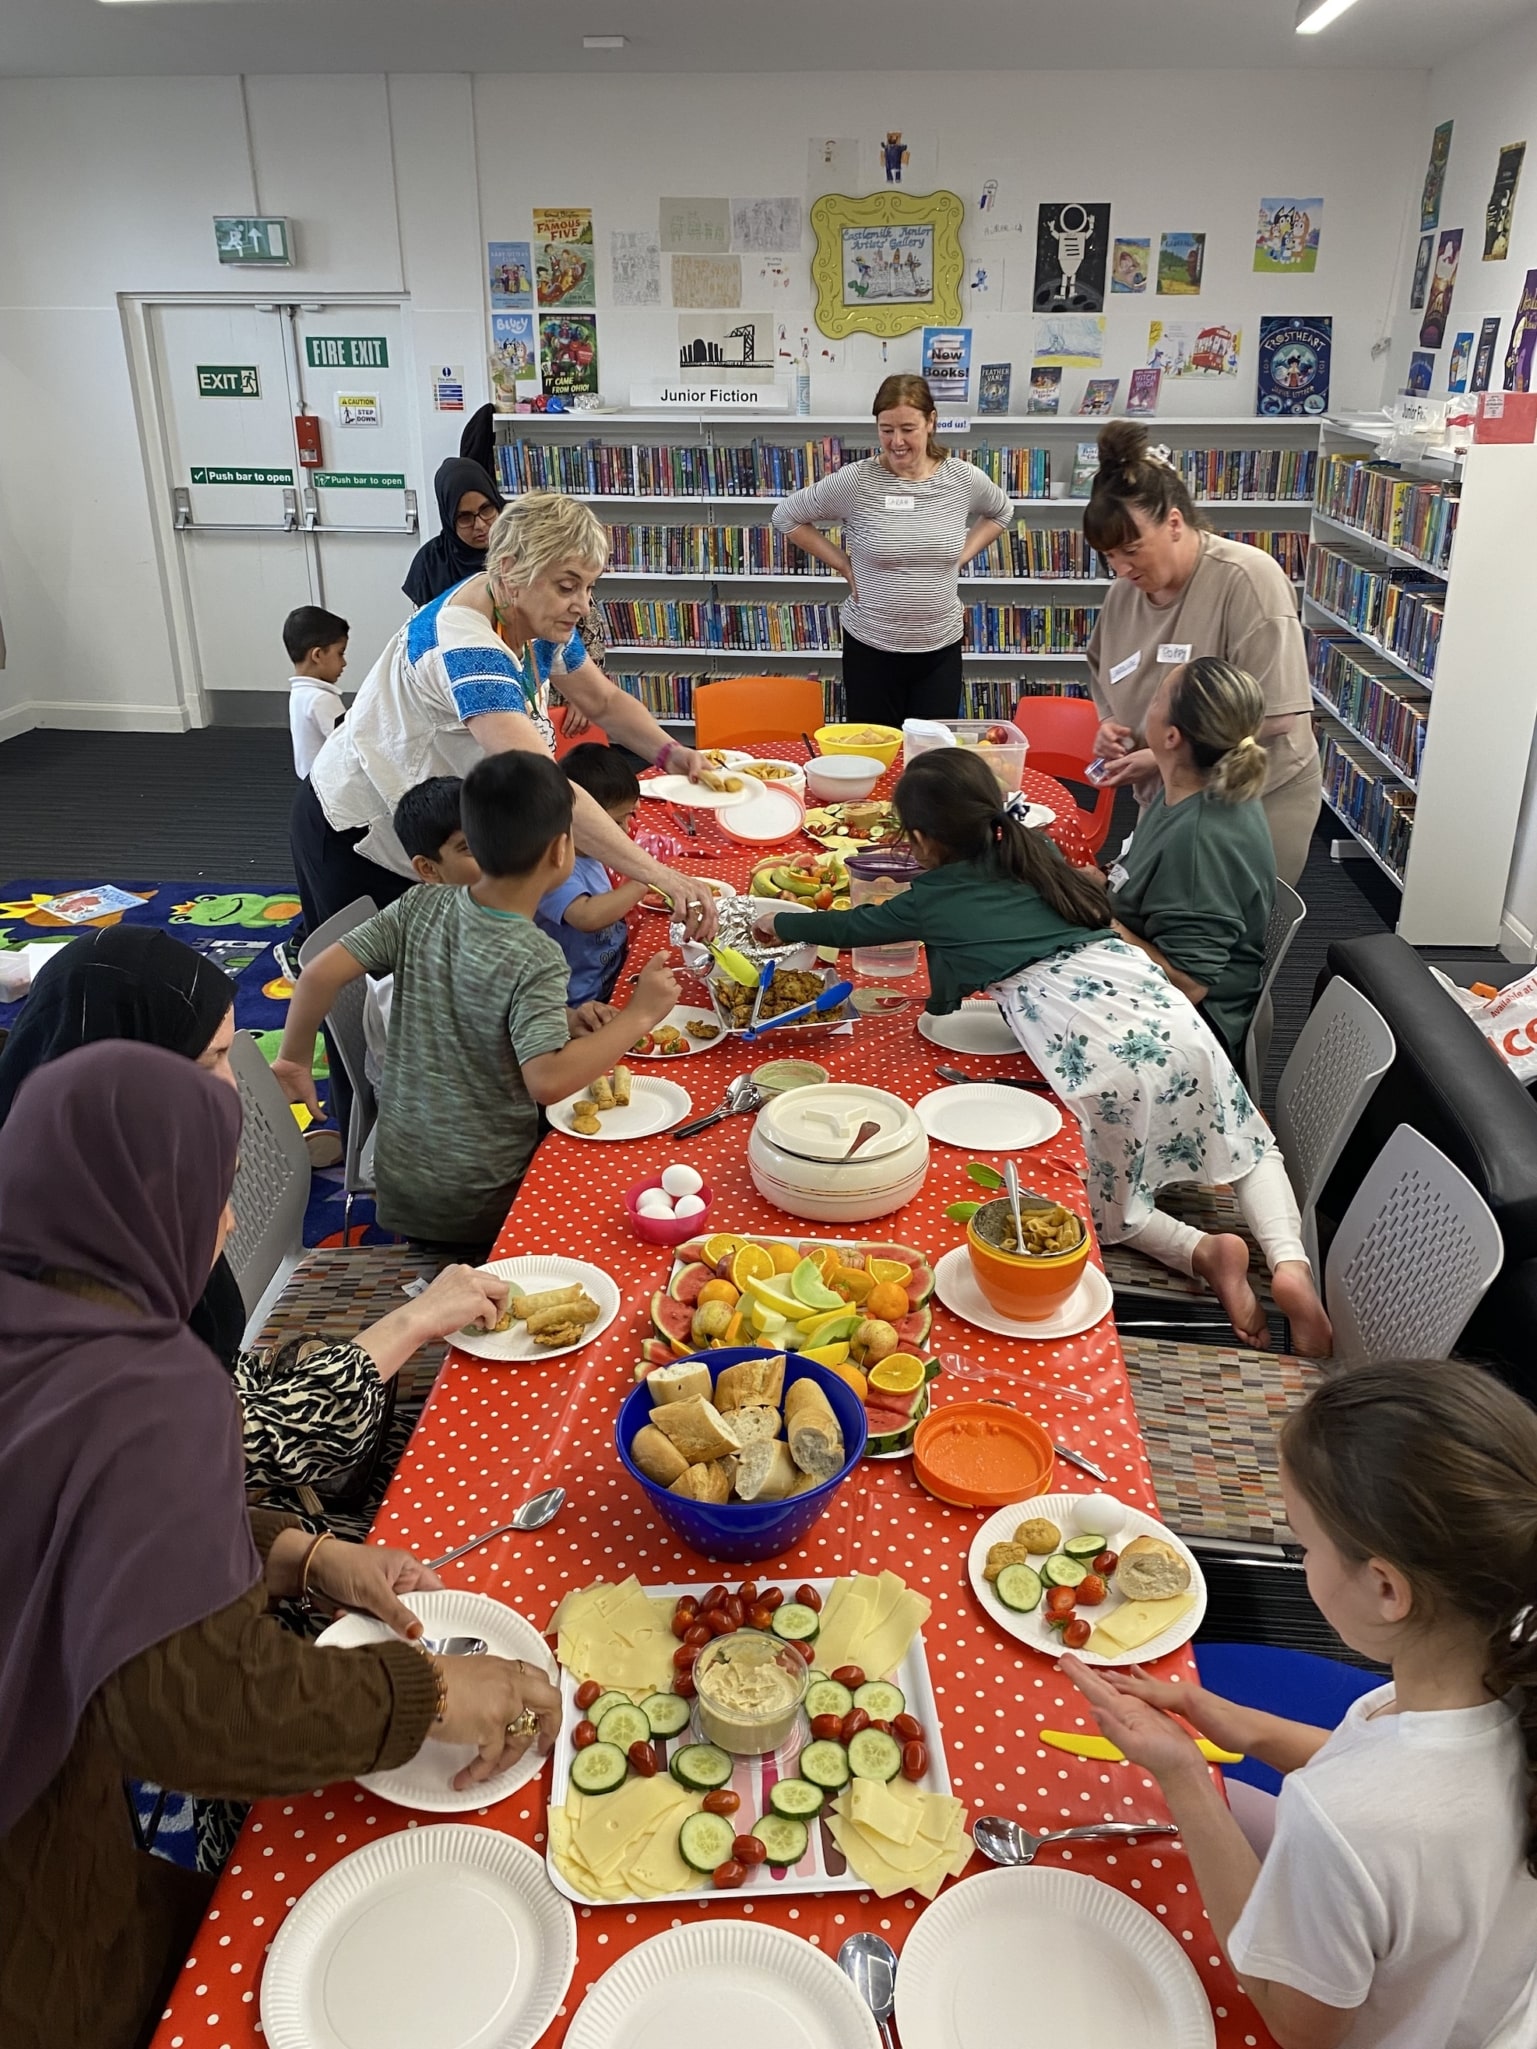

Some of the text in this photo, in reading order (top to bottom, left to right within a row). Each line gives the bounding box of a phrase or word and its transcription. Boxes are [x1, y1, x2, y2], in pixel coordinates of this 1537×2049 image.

[537, 220, 581, 234] FAMOUS
[843, 226, 892, 241] Castlemilk
[550, 228, 579, 241] FIVE
[889, 237, 925, 250] Gallery
[1264, 331, 1326, 352] FROSTHEART
[312, 340, 382, 365] FIRE EXIT
[931, 348, 963, 360] New
[923, 367, 969, 378] Books!
[199, 373, 239, 390] EXIT
[545, 377, 574, 386] IT CAME
[552, 385, 569, 394] FROM
[660, 388, 758, 402] Junior Fiction
[937, 420, 952, 428] ead
[208, 471, 291, 484] Push bar to open
[331, 475, 402, 486] Push bar to open
[1490, 984, 1533, 1018] Available at
